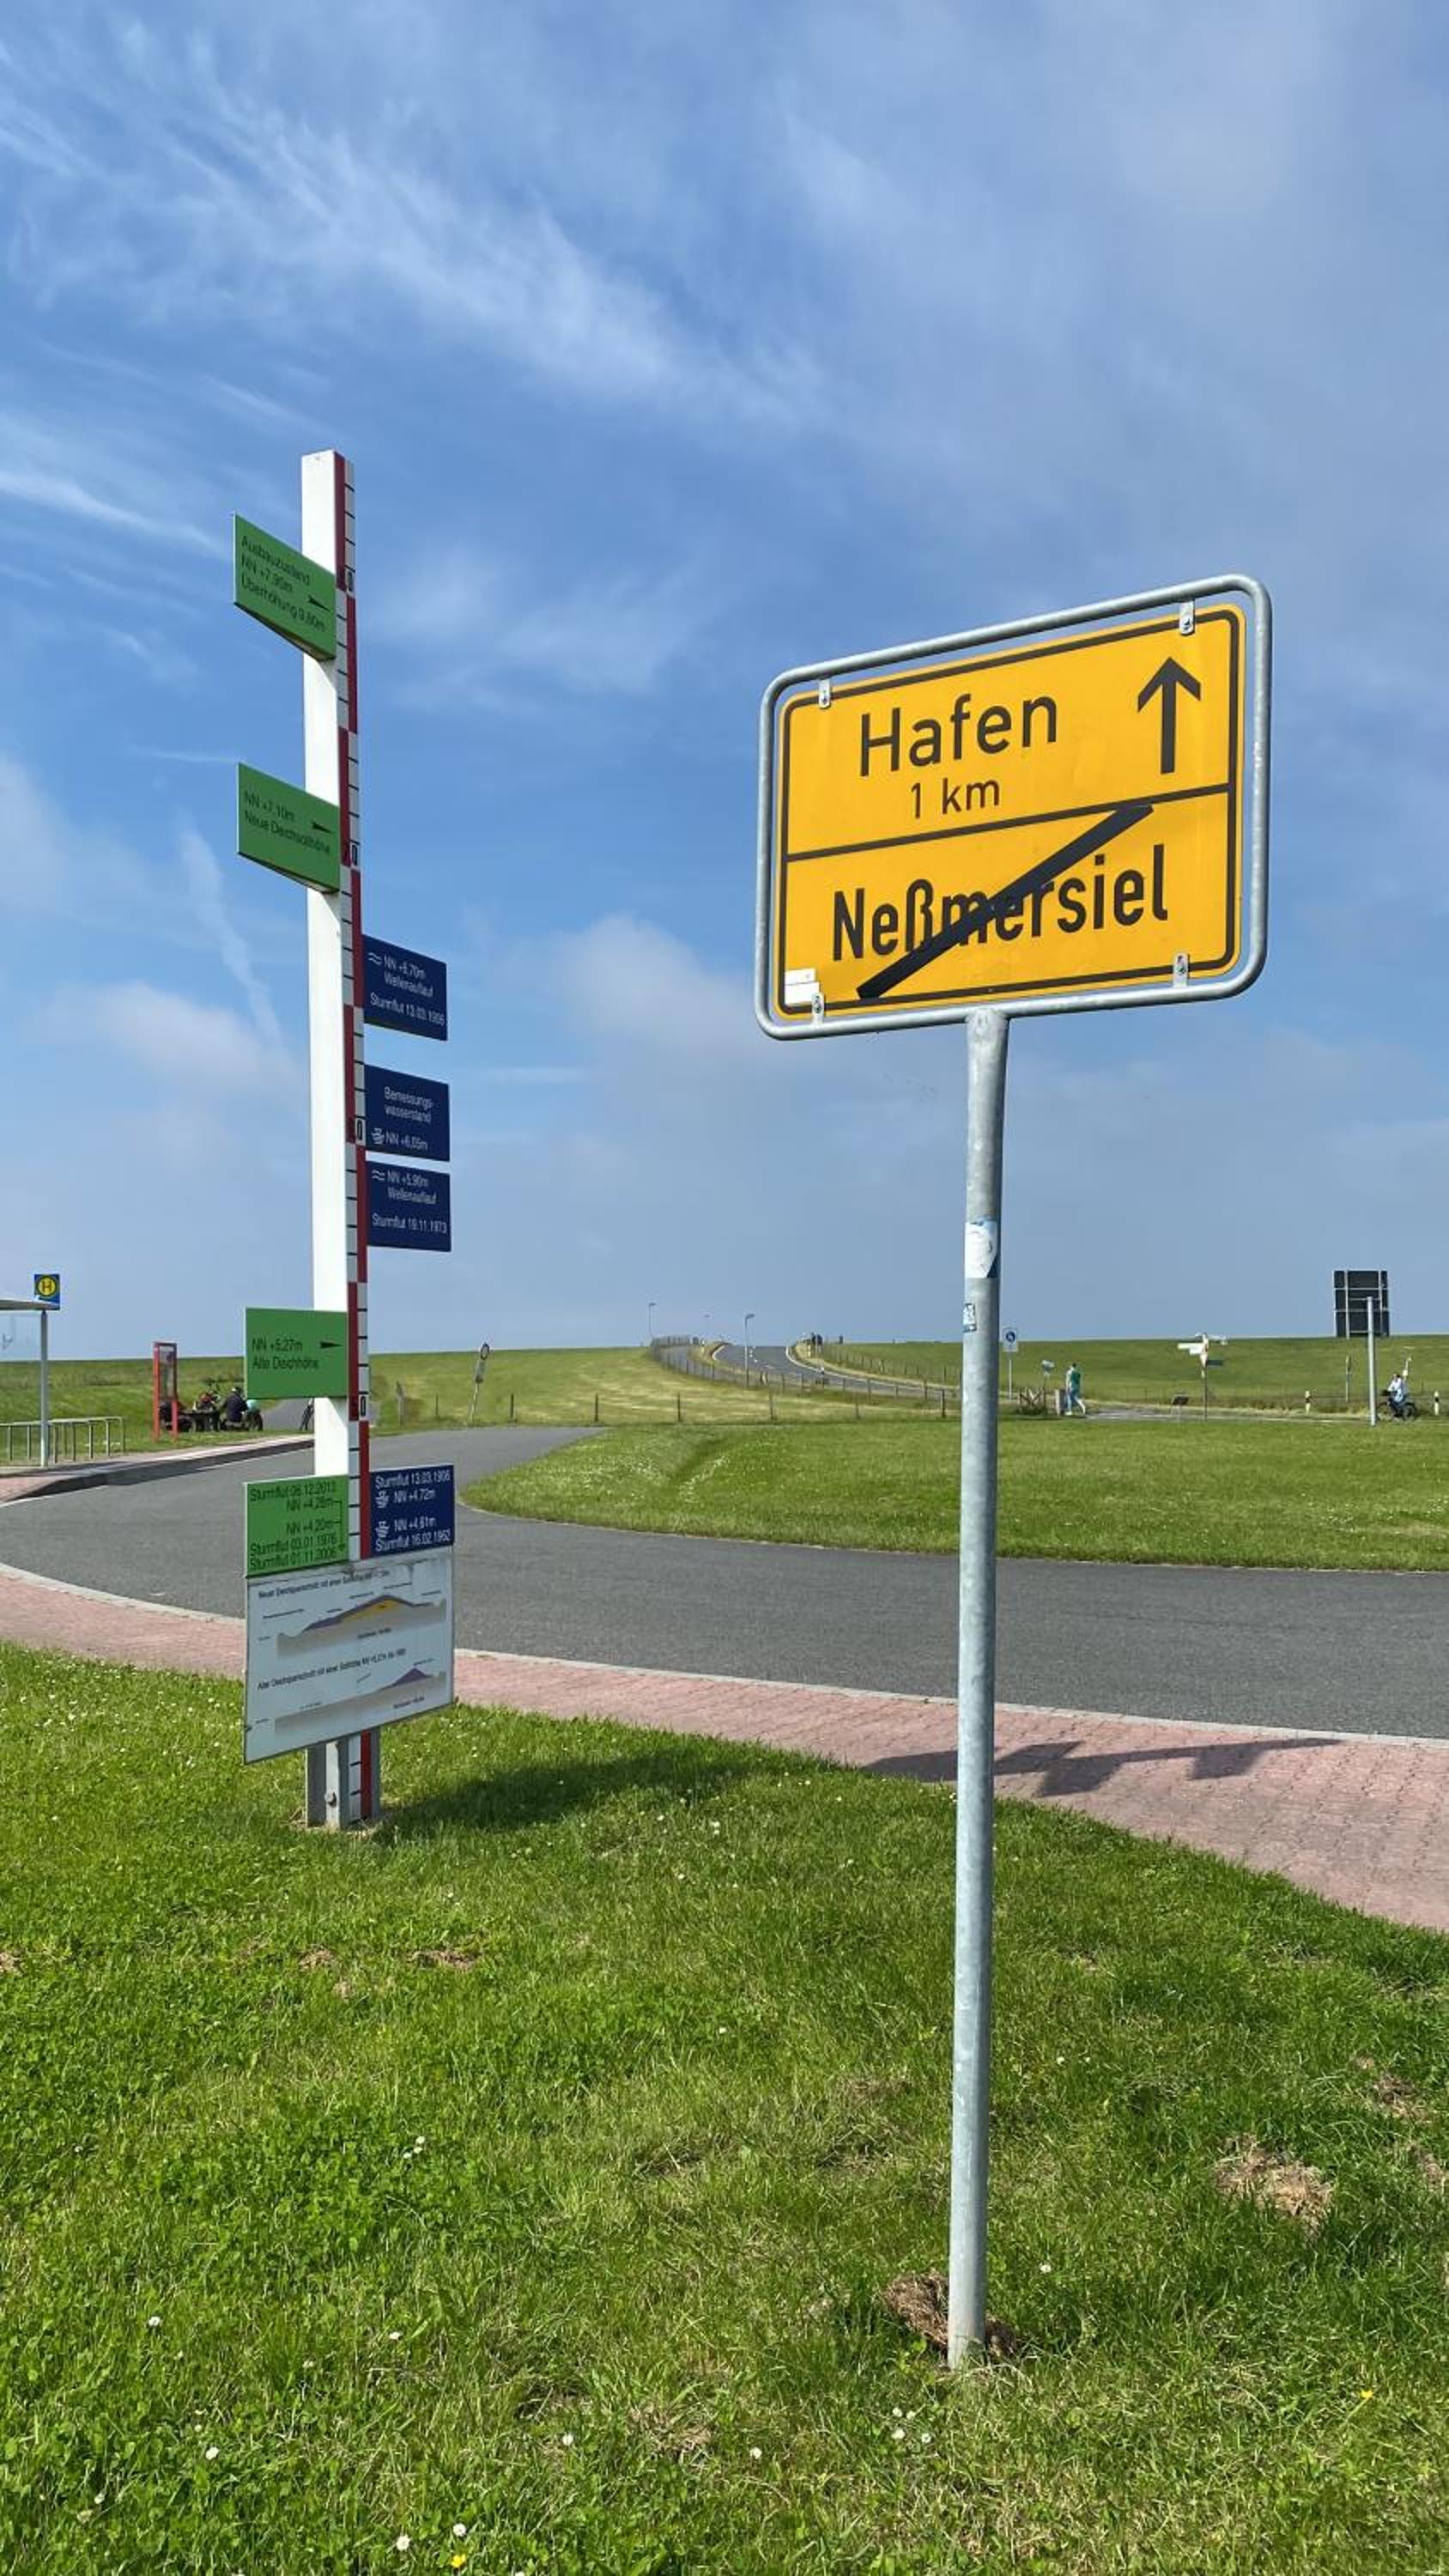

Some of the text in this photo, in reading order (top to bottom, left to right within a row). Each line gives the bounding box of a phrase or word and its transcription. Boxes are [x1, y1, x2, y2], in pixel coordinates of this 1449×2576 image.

[241, 553, 257, 574] NN
[859, 693, 1057, 776] Hafen
[245, 790, 259, 809] NN
[911, 776, 1000, 819] 1 km
[245, 810, 269, 830] Neue
[832, 843, 1168, 961] Neßmersiel
[384, 954, 397, 972] NN
[370, 992, 404, 1015] Sturmflut
[386, 1131, 399, 1145] NN
[387, 1170, 400, 1183] NN
[372, 1212, 406, 1229] Sturmflut
[252, 1338, 268, 1352] NN
[252, 1357, 270, 1370] Alte
[375, 1473, 409, 1491] Sturmflut
[250, 1485, 289, 1503] Sturmflut
[394, 1490, 408, 1504] NN
[286, 1498, 301, 1512] NN
[286, 1522, 301, 1535] NN
[394, 1518, 408, 1533] NN
[250, 1540, 289, 1558] Sturmflut
[375, 1534, 410, 1552] Sturmflut
[250, 1554, 289, 1571] Sturmflut
